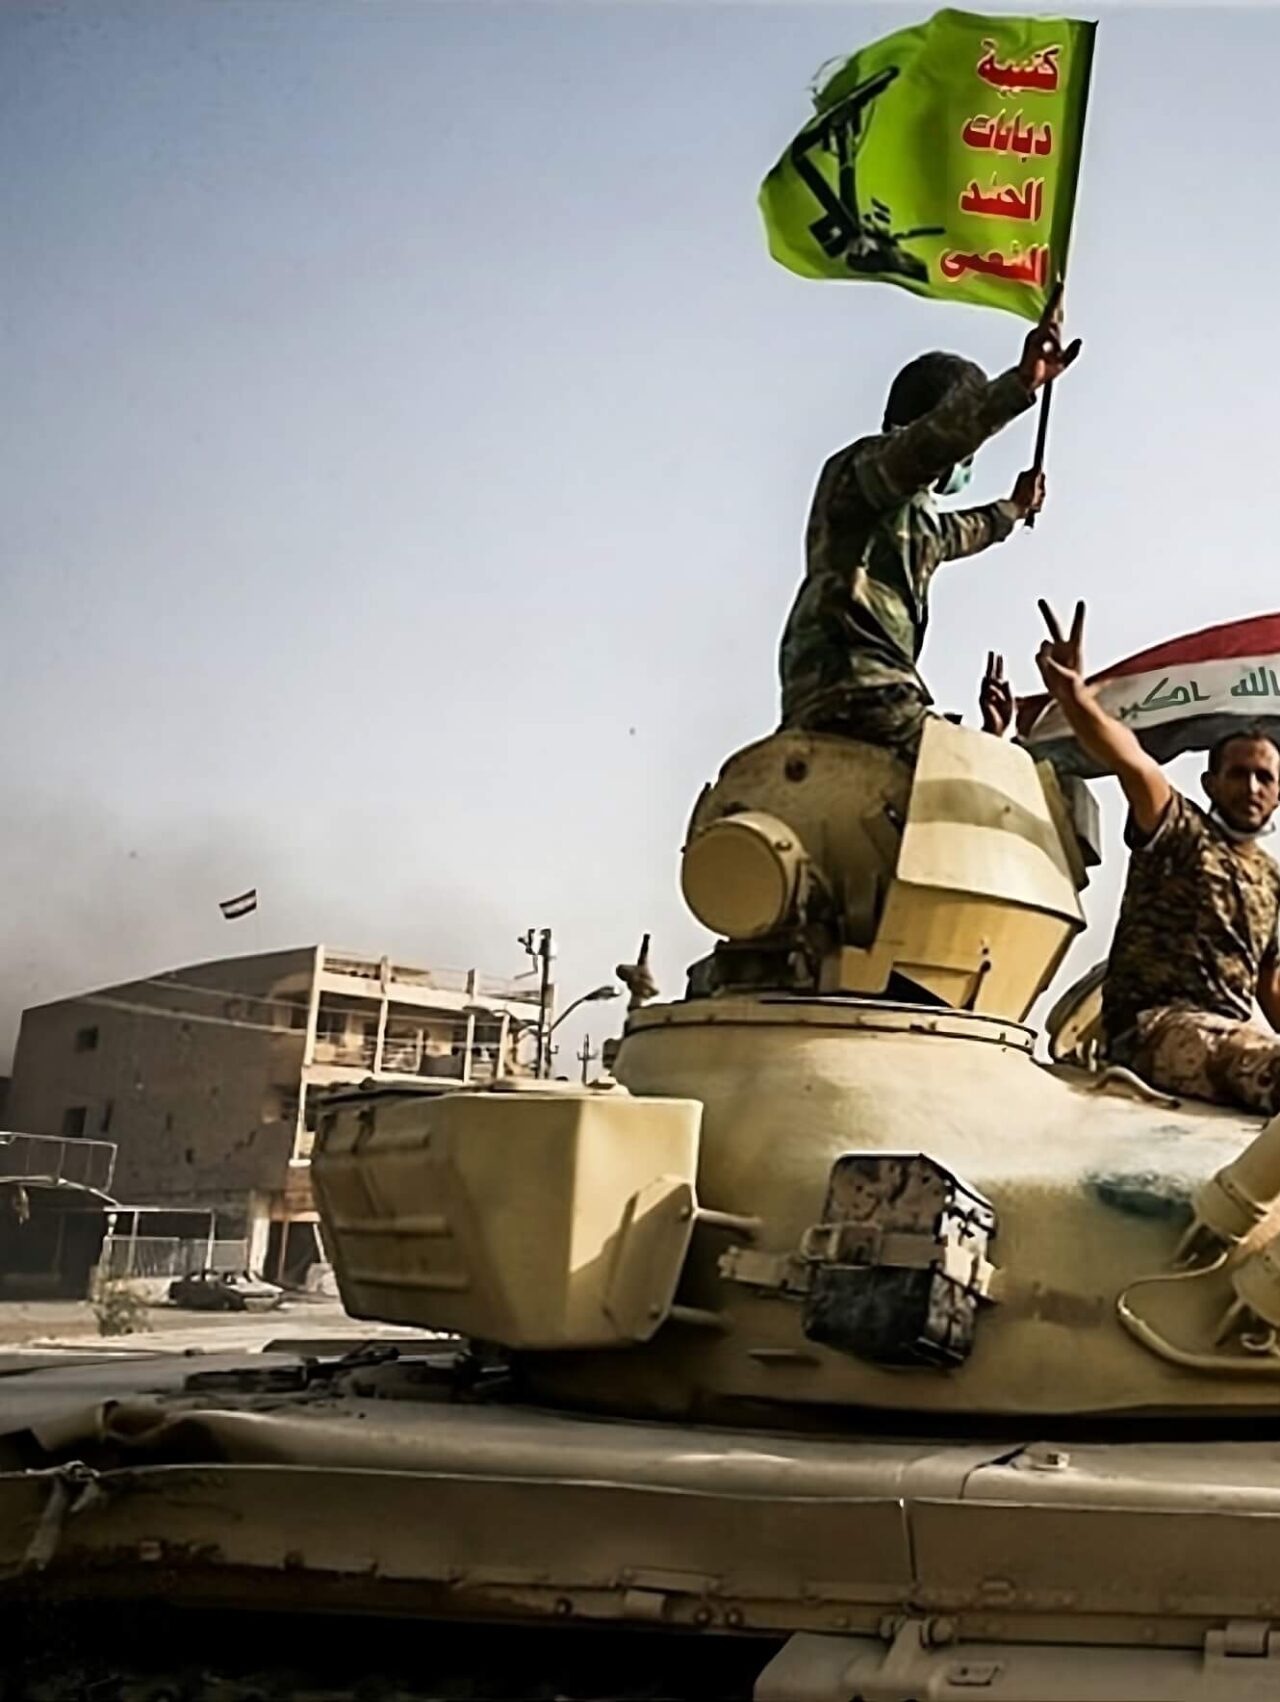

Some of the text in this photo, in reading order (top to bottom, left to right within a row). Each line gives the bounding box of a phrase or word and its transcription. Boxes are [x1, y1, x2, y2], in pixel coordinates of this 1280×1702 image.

[977, 38, 1062, 97] كتيبة
[962, 108, 1052, 163] دبابات
[960, 172, 1044, 222] الحشد
